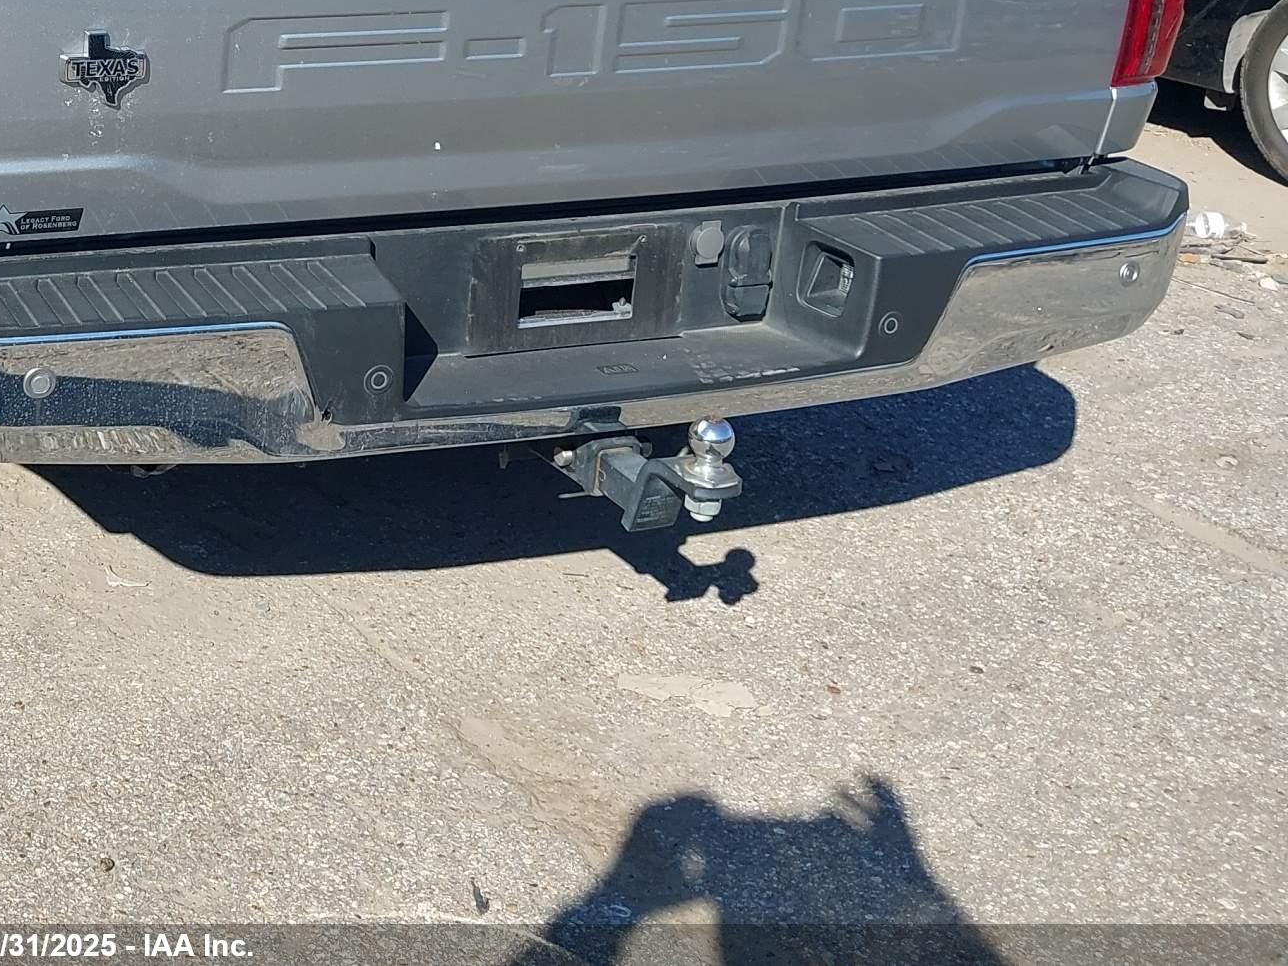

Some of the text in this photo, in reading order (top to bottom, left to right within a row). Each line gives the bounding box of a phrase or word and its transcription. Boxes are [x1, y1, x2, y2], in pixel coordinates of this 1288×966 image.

[71, 59, 139, 77] TEXAS
[20, 215, 71, 224] LEGACY FORD
[32, 221, 77, 230] ROSENBERG
